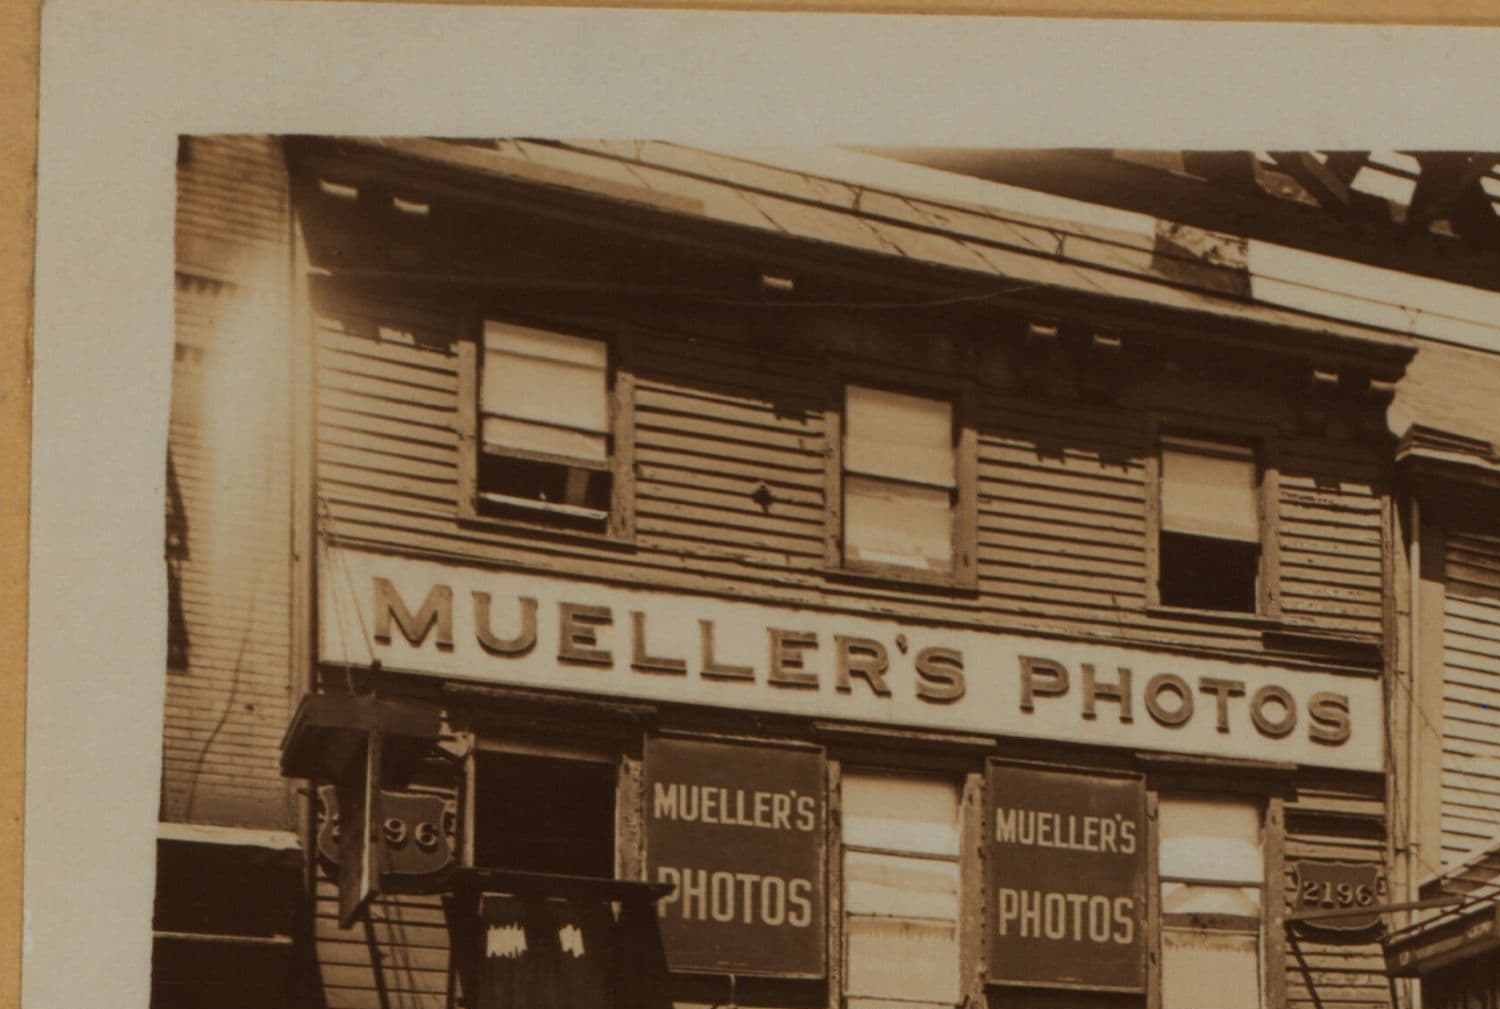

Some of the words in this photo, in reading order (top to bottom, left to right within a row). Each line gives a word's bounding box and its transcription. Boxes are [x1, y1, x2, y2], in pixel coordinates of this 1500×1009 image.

[373, 576, 967, 705] MUELLER'S
[1018, 654, 1352, 746] PHOTOS
[653, 781, 816, 832] MUELLER'S
[995, 806, 1137, 857] MUELLER'S
[656, 866, 813, 929] PHOTOS
[998, 889, 1135, 946] PHOTOS
[1302, 878, 1374, 909] 2196
